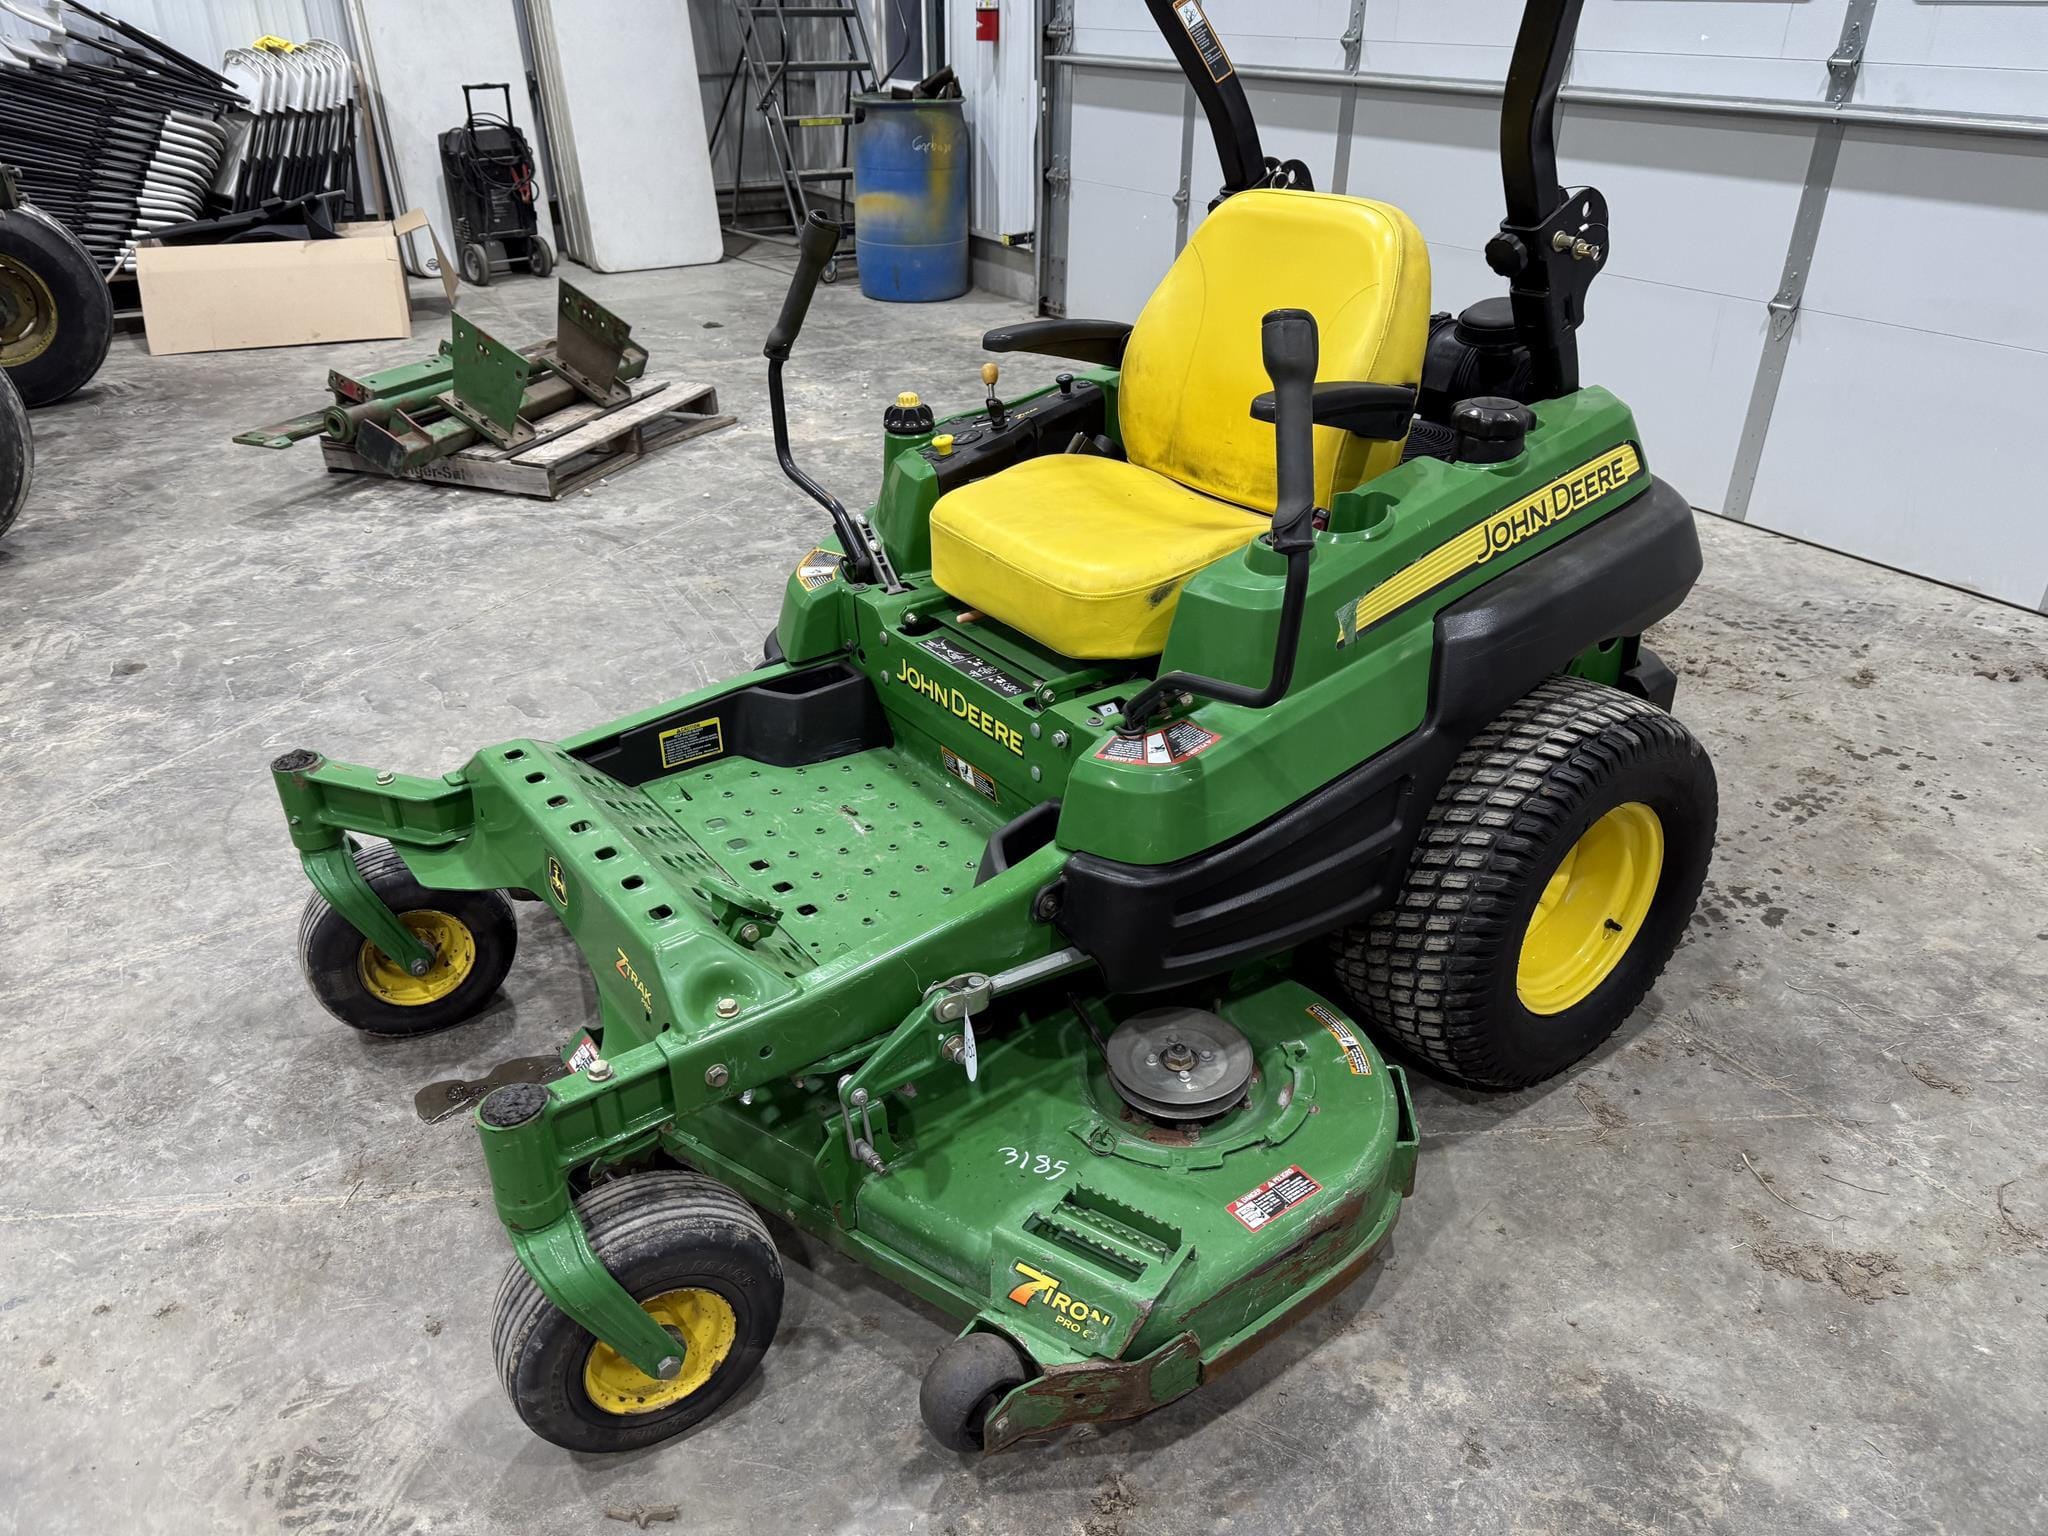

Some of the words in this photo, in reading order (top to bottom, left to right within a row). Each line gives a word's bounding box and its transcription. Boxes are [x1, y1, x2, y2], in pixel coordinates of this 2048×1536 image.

[1478, 498, 1548, 560] JOHN
[1551, 457, 1625, 517] DEERE
[897, 658, 948, 708] JOHN
[951, 688, 1023, 756] DEERE
[997, 1146, 1070, 1180] 3185
[1055, 1315, 1081, 1333] PRO
